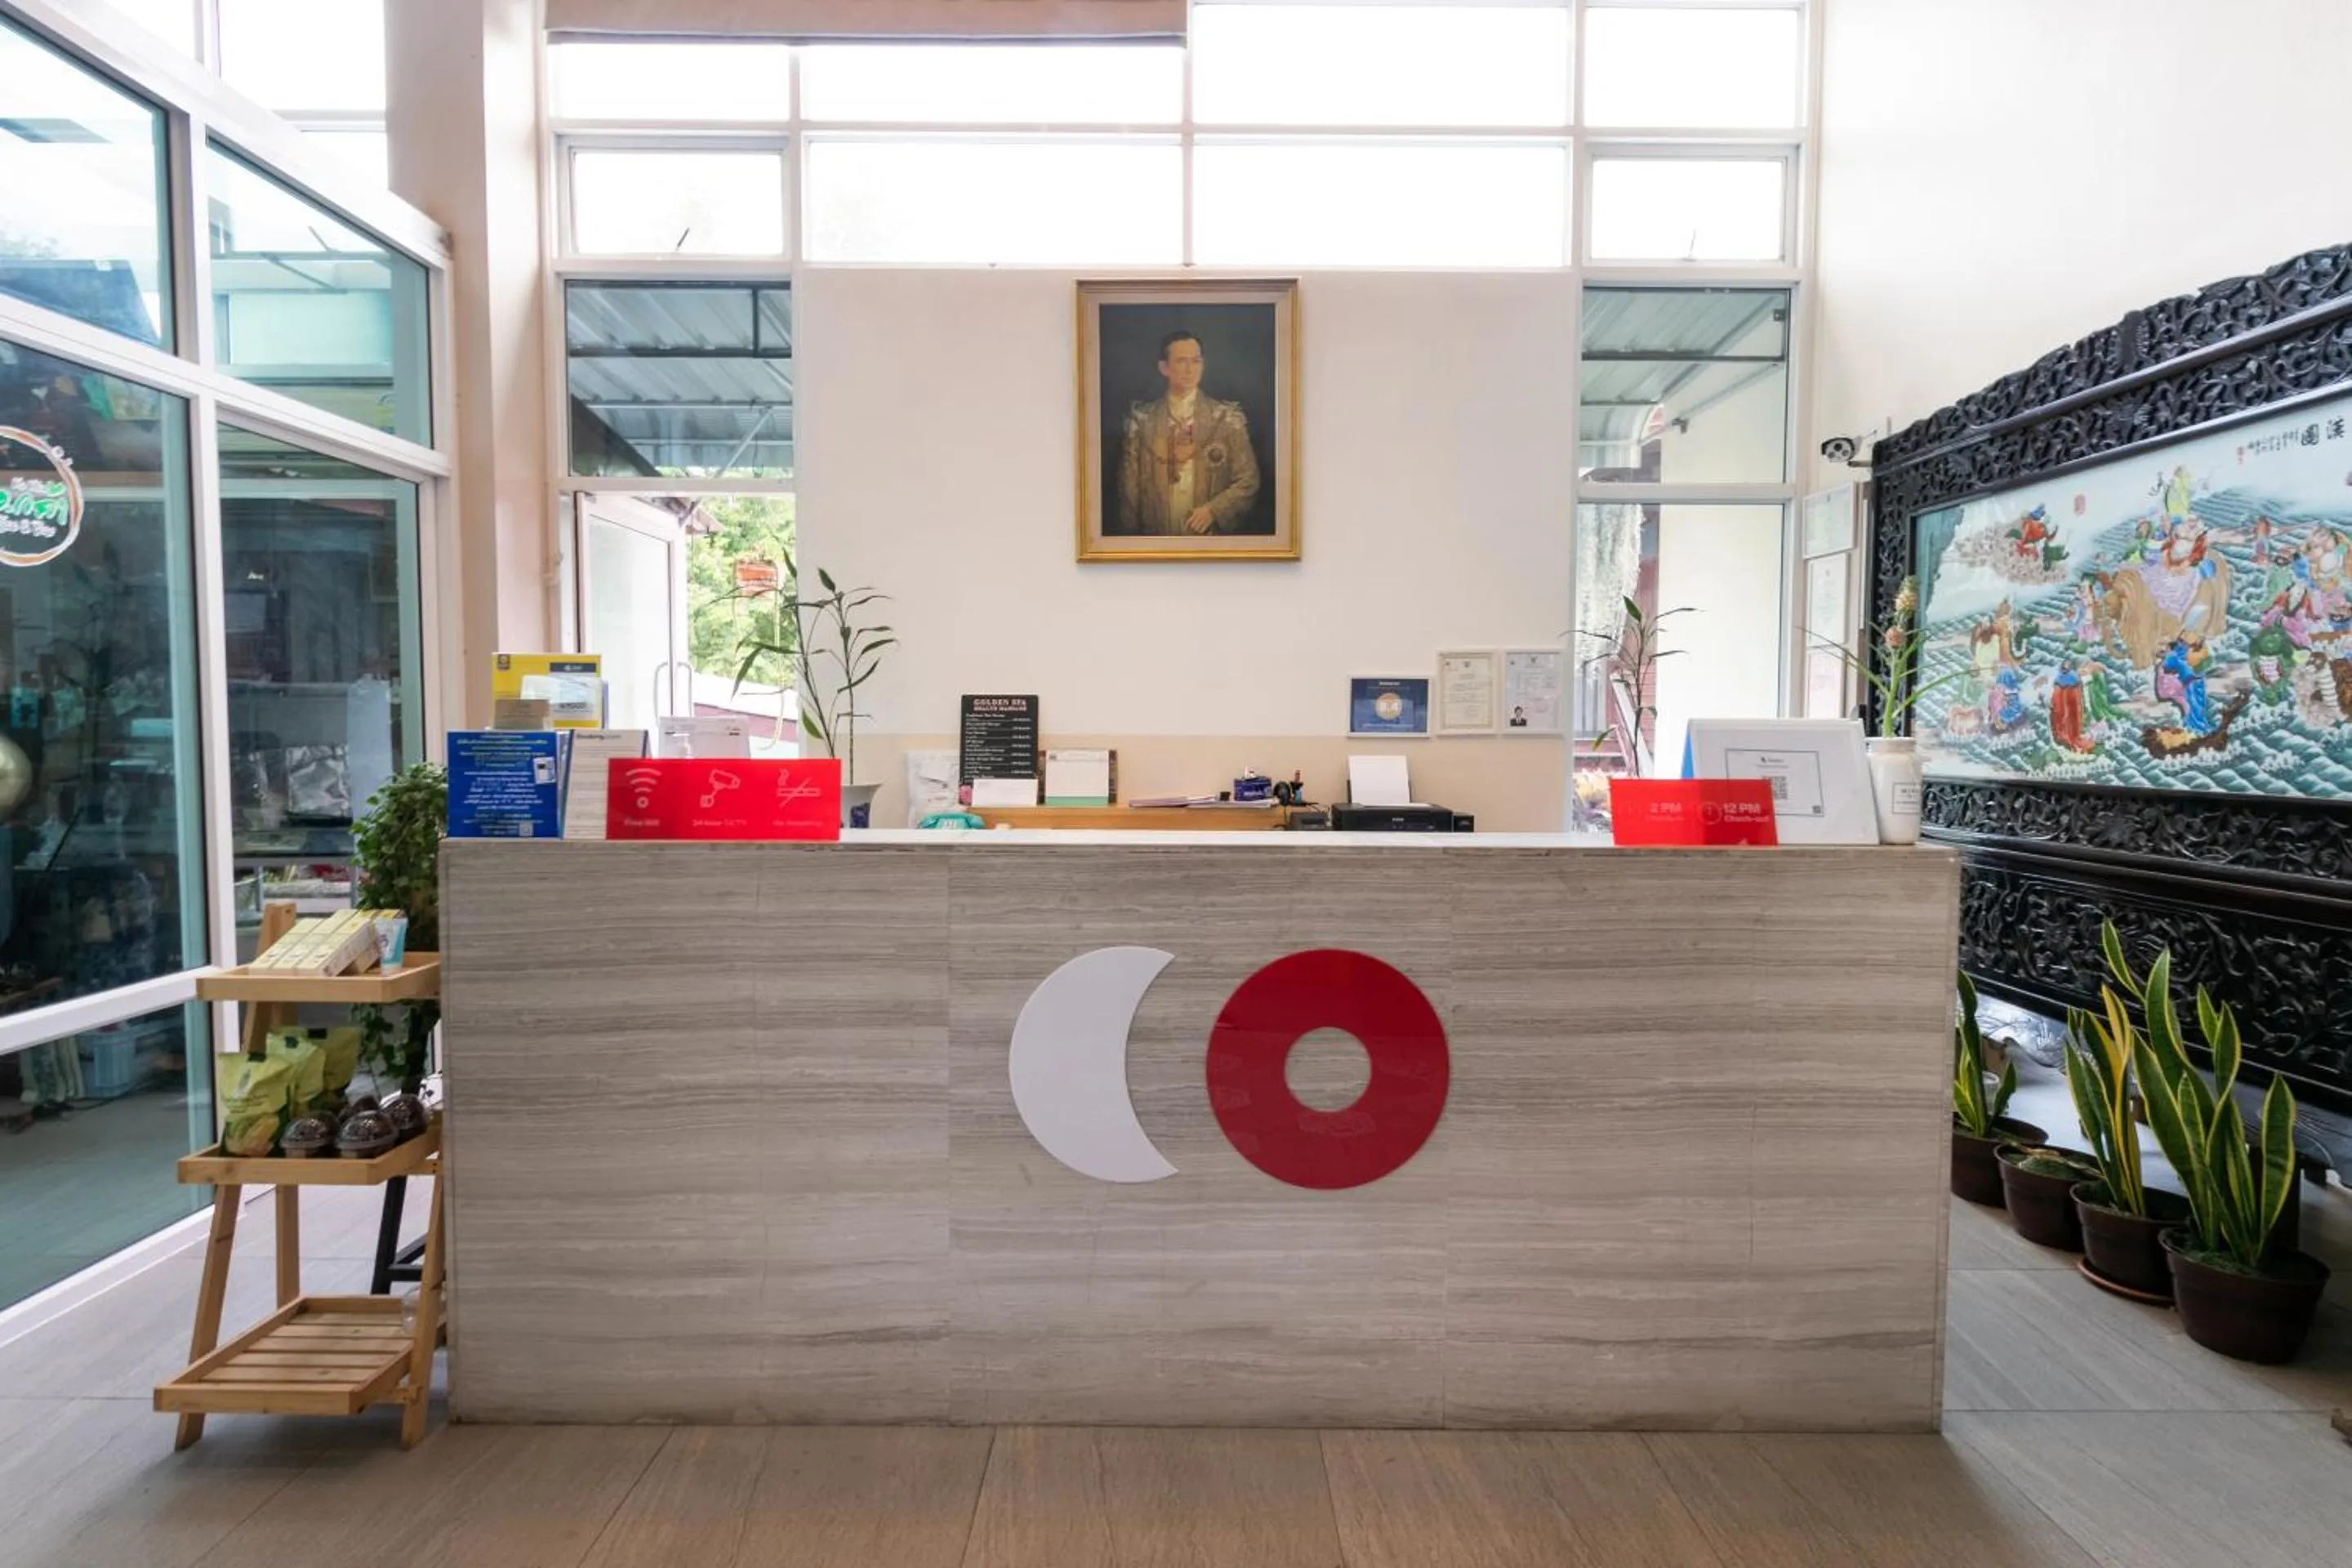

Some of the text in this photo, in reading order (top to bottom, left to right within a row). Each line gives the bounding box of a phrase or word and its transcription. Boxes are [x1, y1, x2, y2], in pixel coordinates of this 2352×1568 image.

[1660, 802, 1681, 813] PM
[1723, 803, 1761, 813] 12 PM
[724, 818, 747, 826] CCTV
